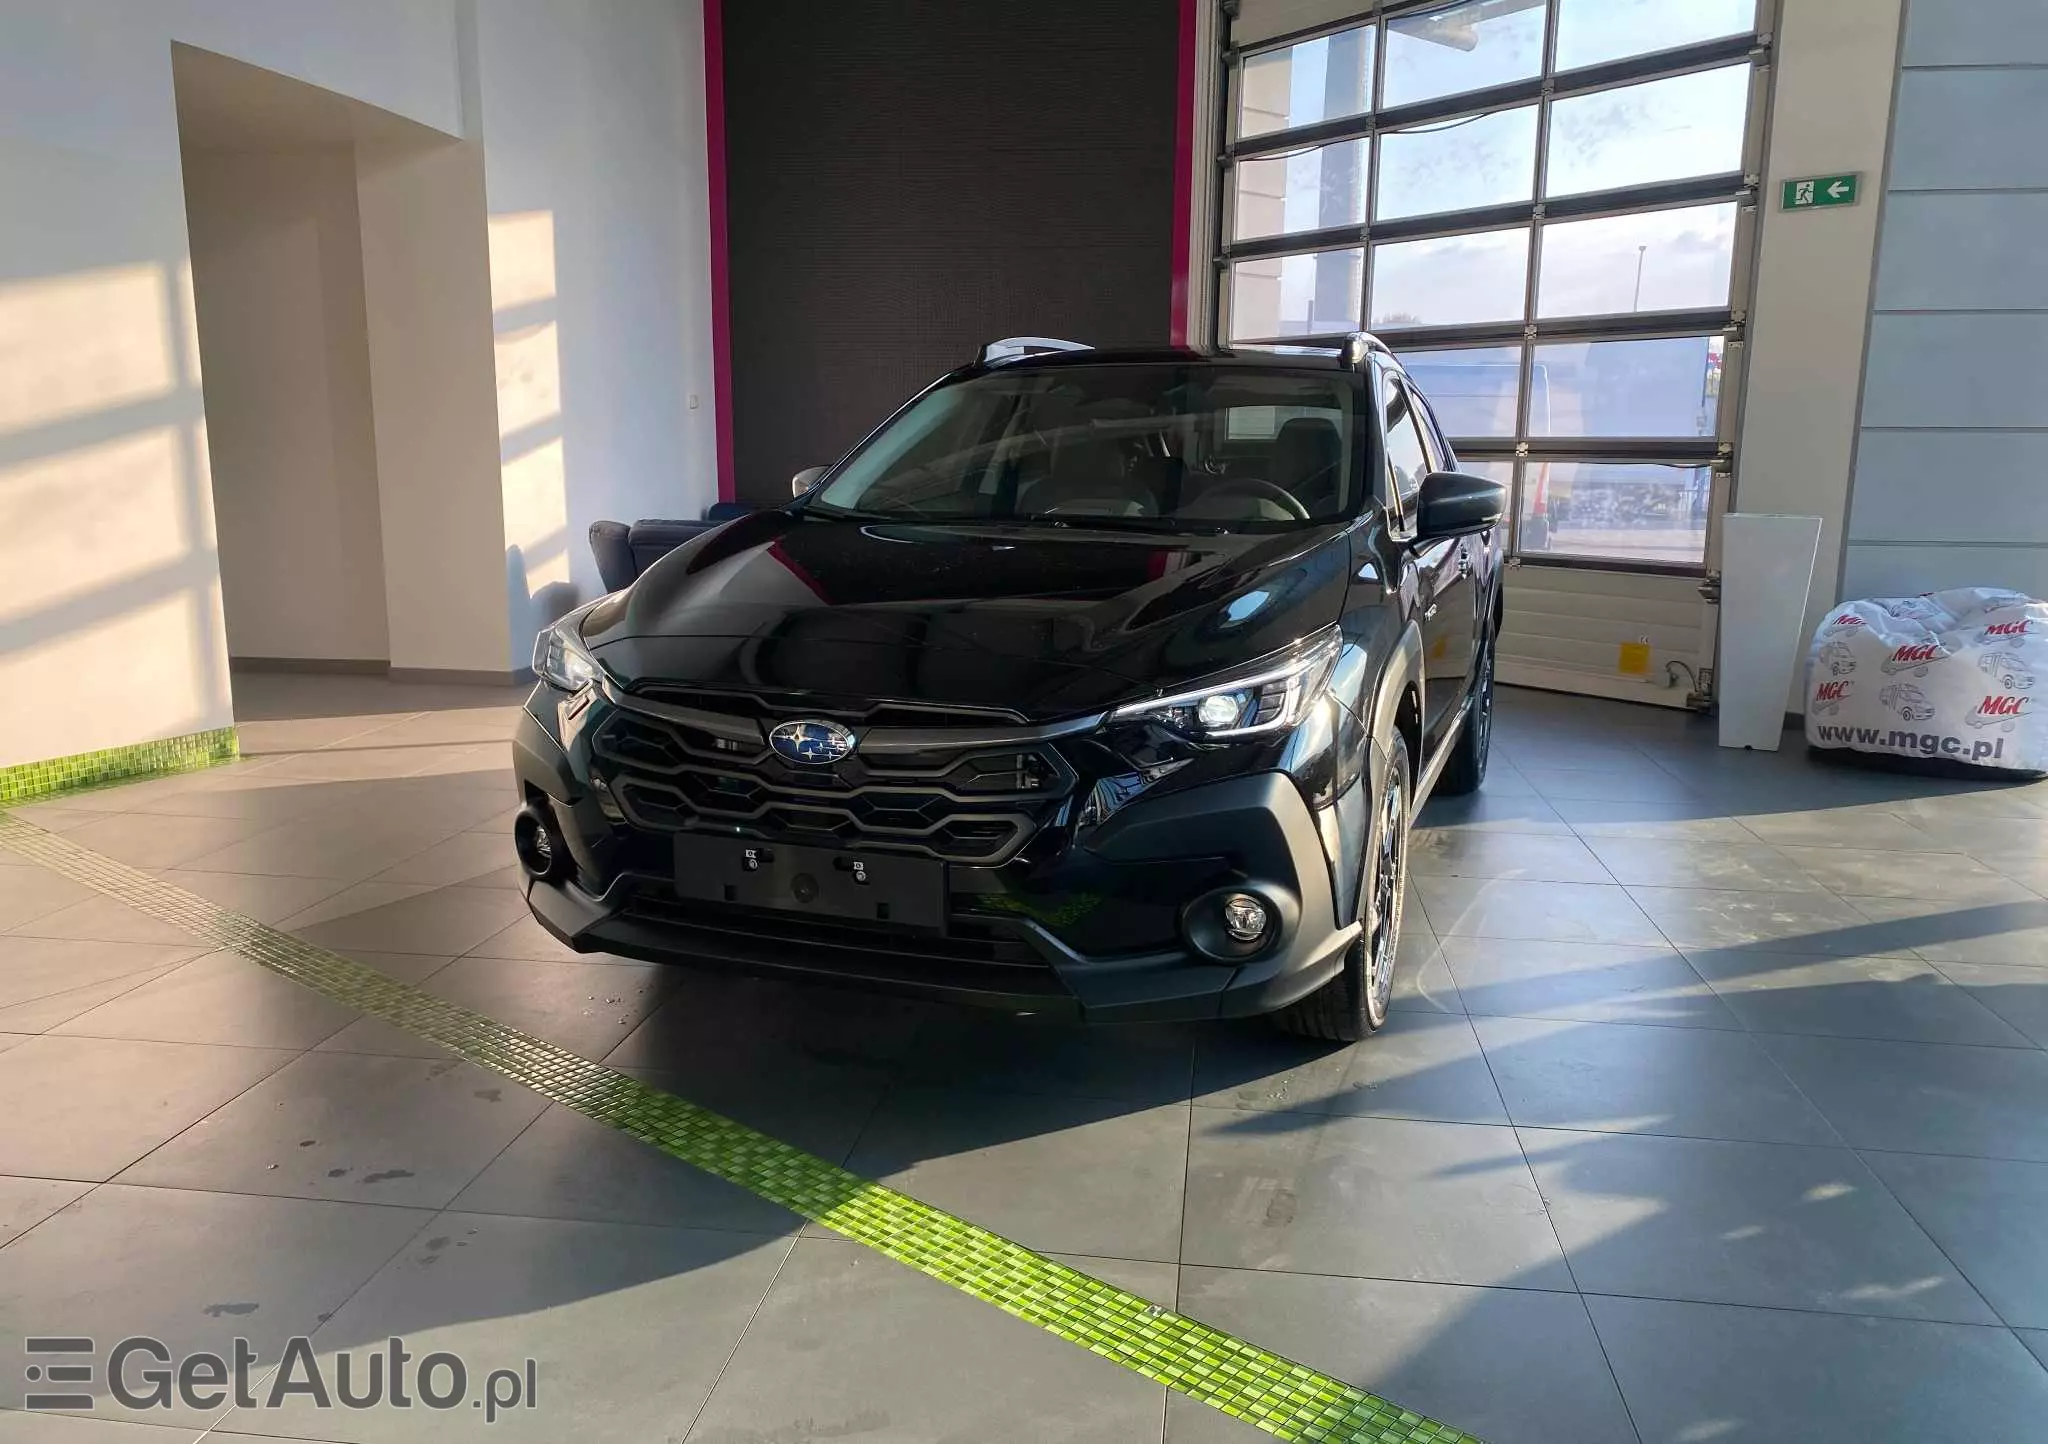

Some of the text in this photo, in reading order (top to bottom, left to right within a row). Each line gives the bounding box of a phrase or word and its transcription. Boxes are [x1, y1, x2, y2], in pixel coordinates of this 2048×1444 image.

[1892, 645, 1938, 662] MGC
[1816, 681, 1849, 701] MGC
[1977, 696, 2029, 715] MGC
[1817, 725, 2004, 761] www.mgc.pl
